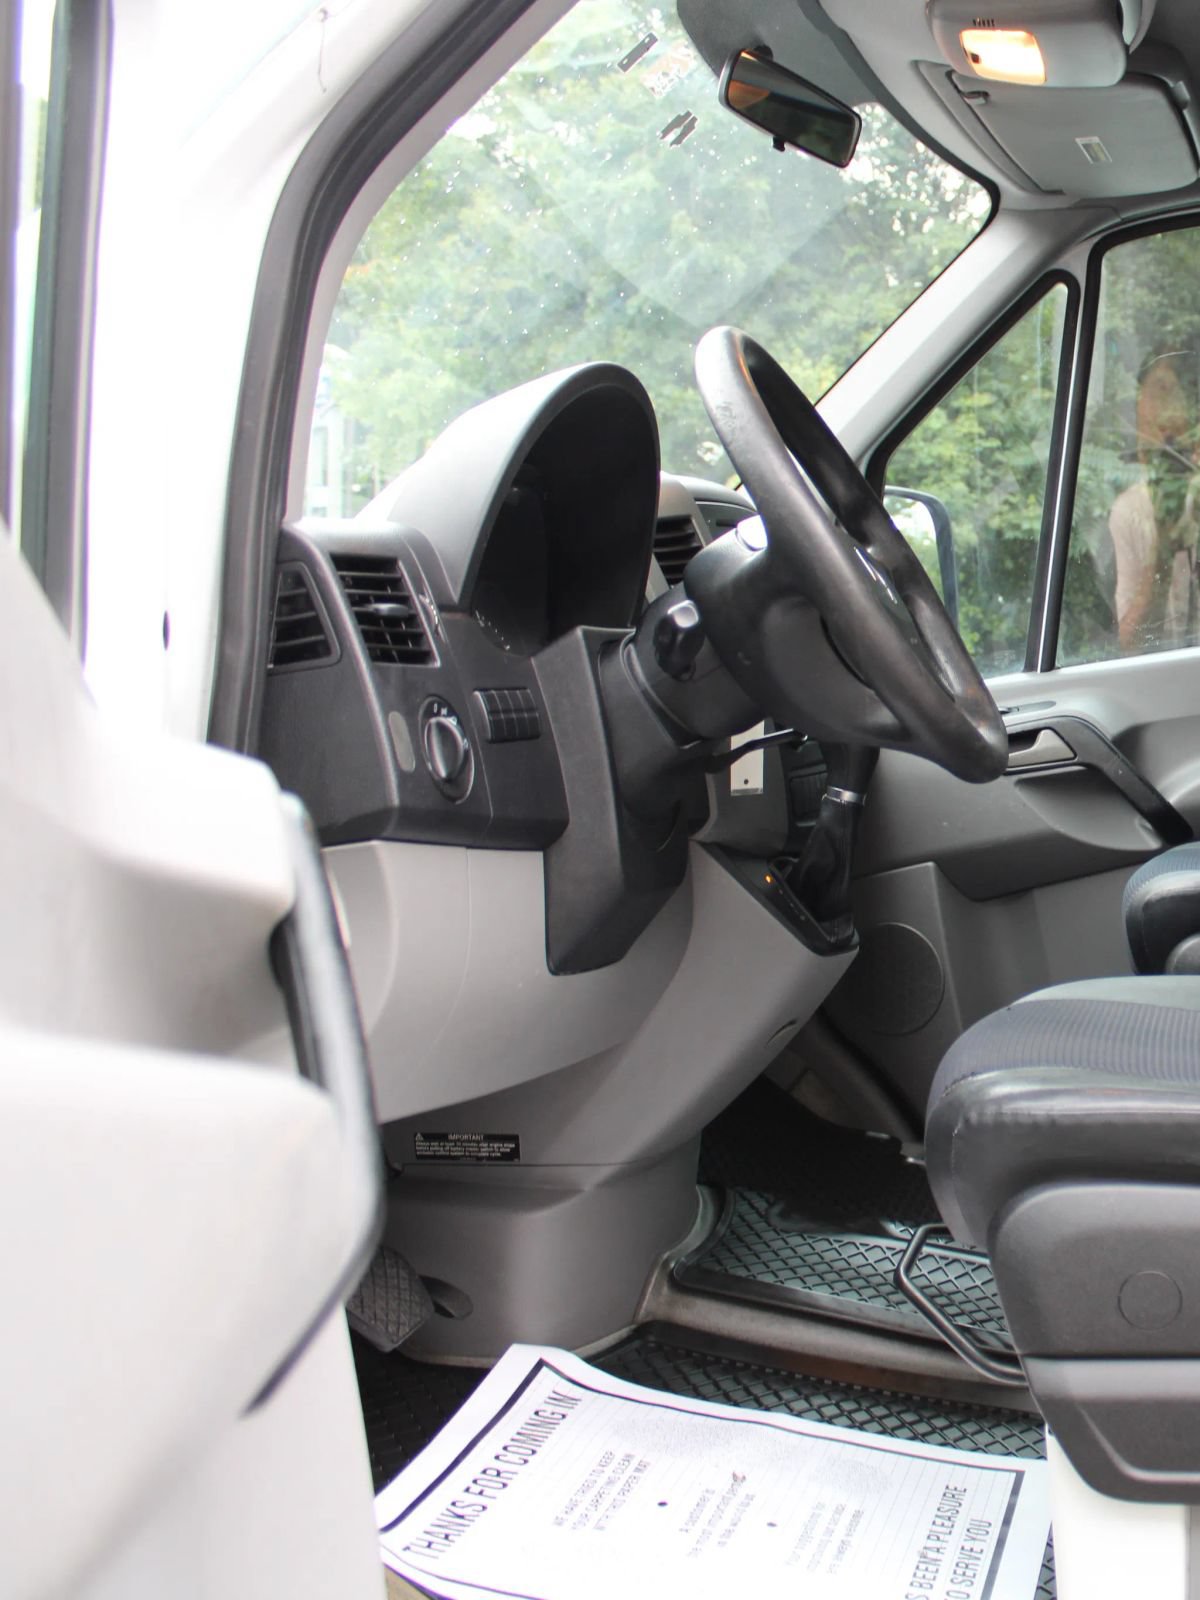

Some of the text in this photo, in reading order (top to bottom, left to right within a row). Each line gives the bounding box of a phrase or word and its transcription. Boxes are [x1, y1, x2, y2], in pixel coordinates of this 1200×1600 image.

[448, 1133, 485, 1142] IMPORTANT
[402, 1390, 582, 1559] THANKS FOR COMING IN
[926, 1484, 967, 1543] PLEASURE
[963, 1518, 992, 1543] YOU
[909, 1548, 943, 1590] BEEN
[922, 1545, 947, 1555] A
[950, 1545, 984, 1587] SERVE
